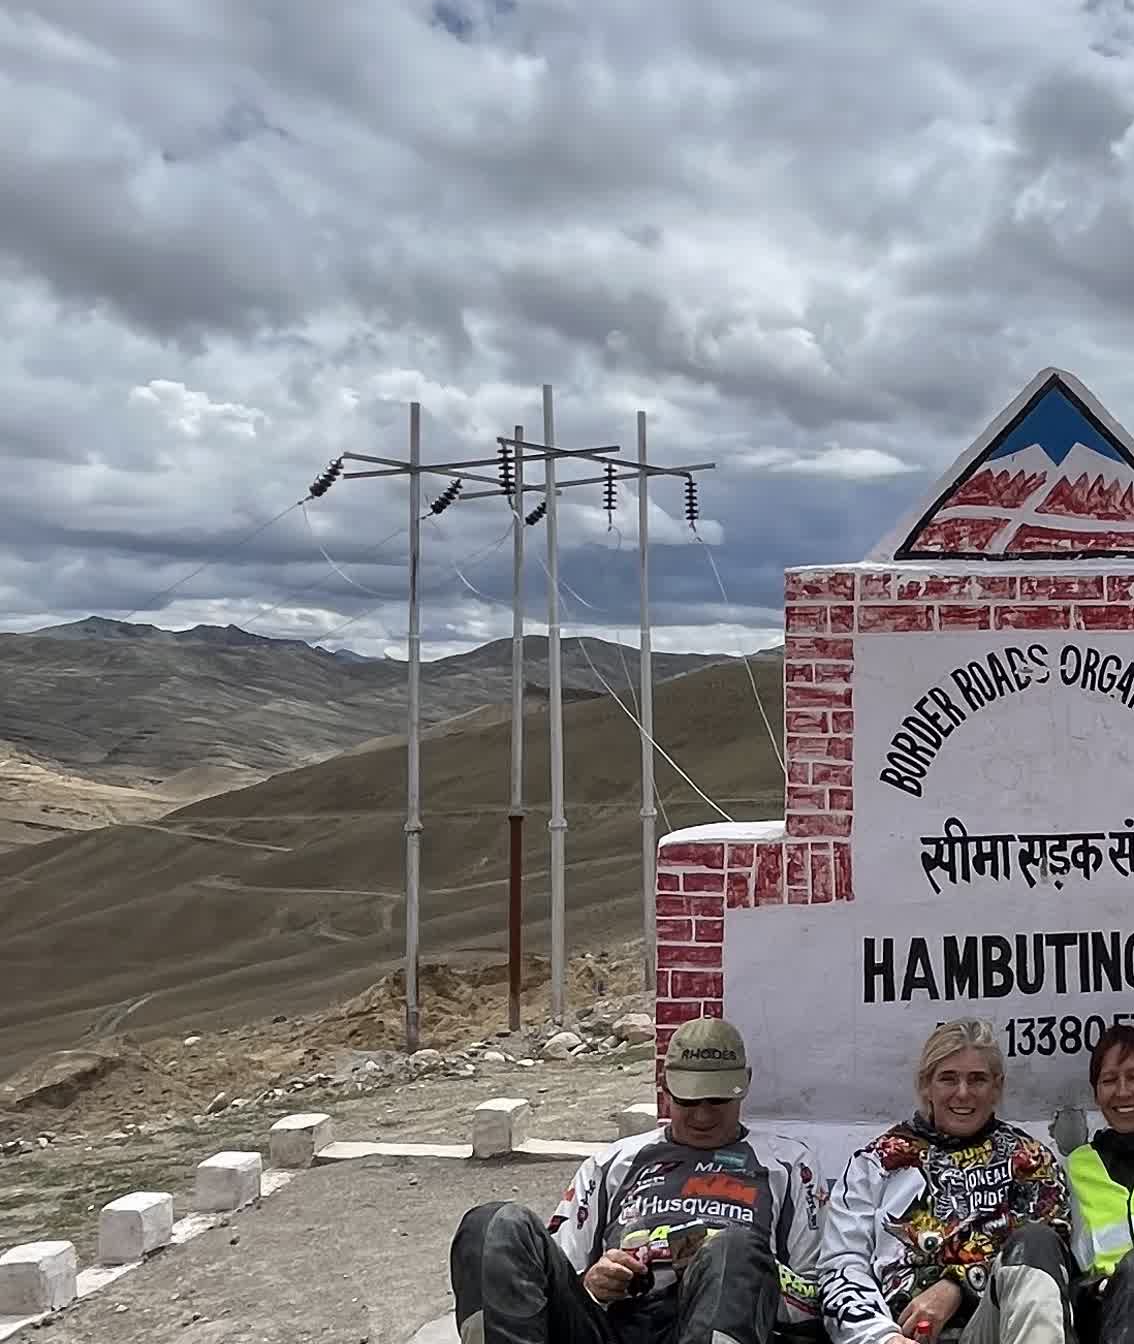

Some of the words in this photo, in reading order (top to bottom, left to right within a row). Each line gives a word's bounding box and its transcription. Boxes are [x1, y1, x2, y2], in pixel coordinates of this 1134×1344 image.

[879, 687, 967, 797] BORDER
[950, 644, 1050, 712] ROADS
[920, 817, 1018, 894] सीमा
[1018, 832, 1106, 891] सड़क
[1005, 1015, 1106, 1058] 13380
[641, 1195, 754, 1223] Husqvarna
